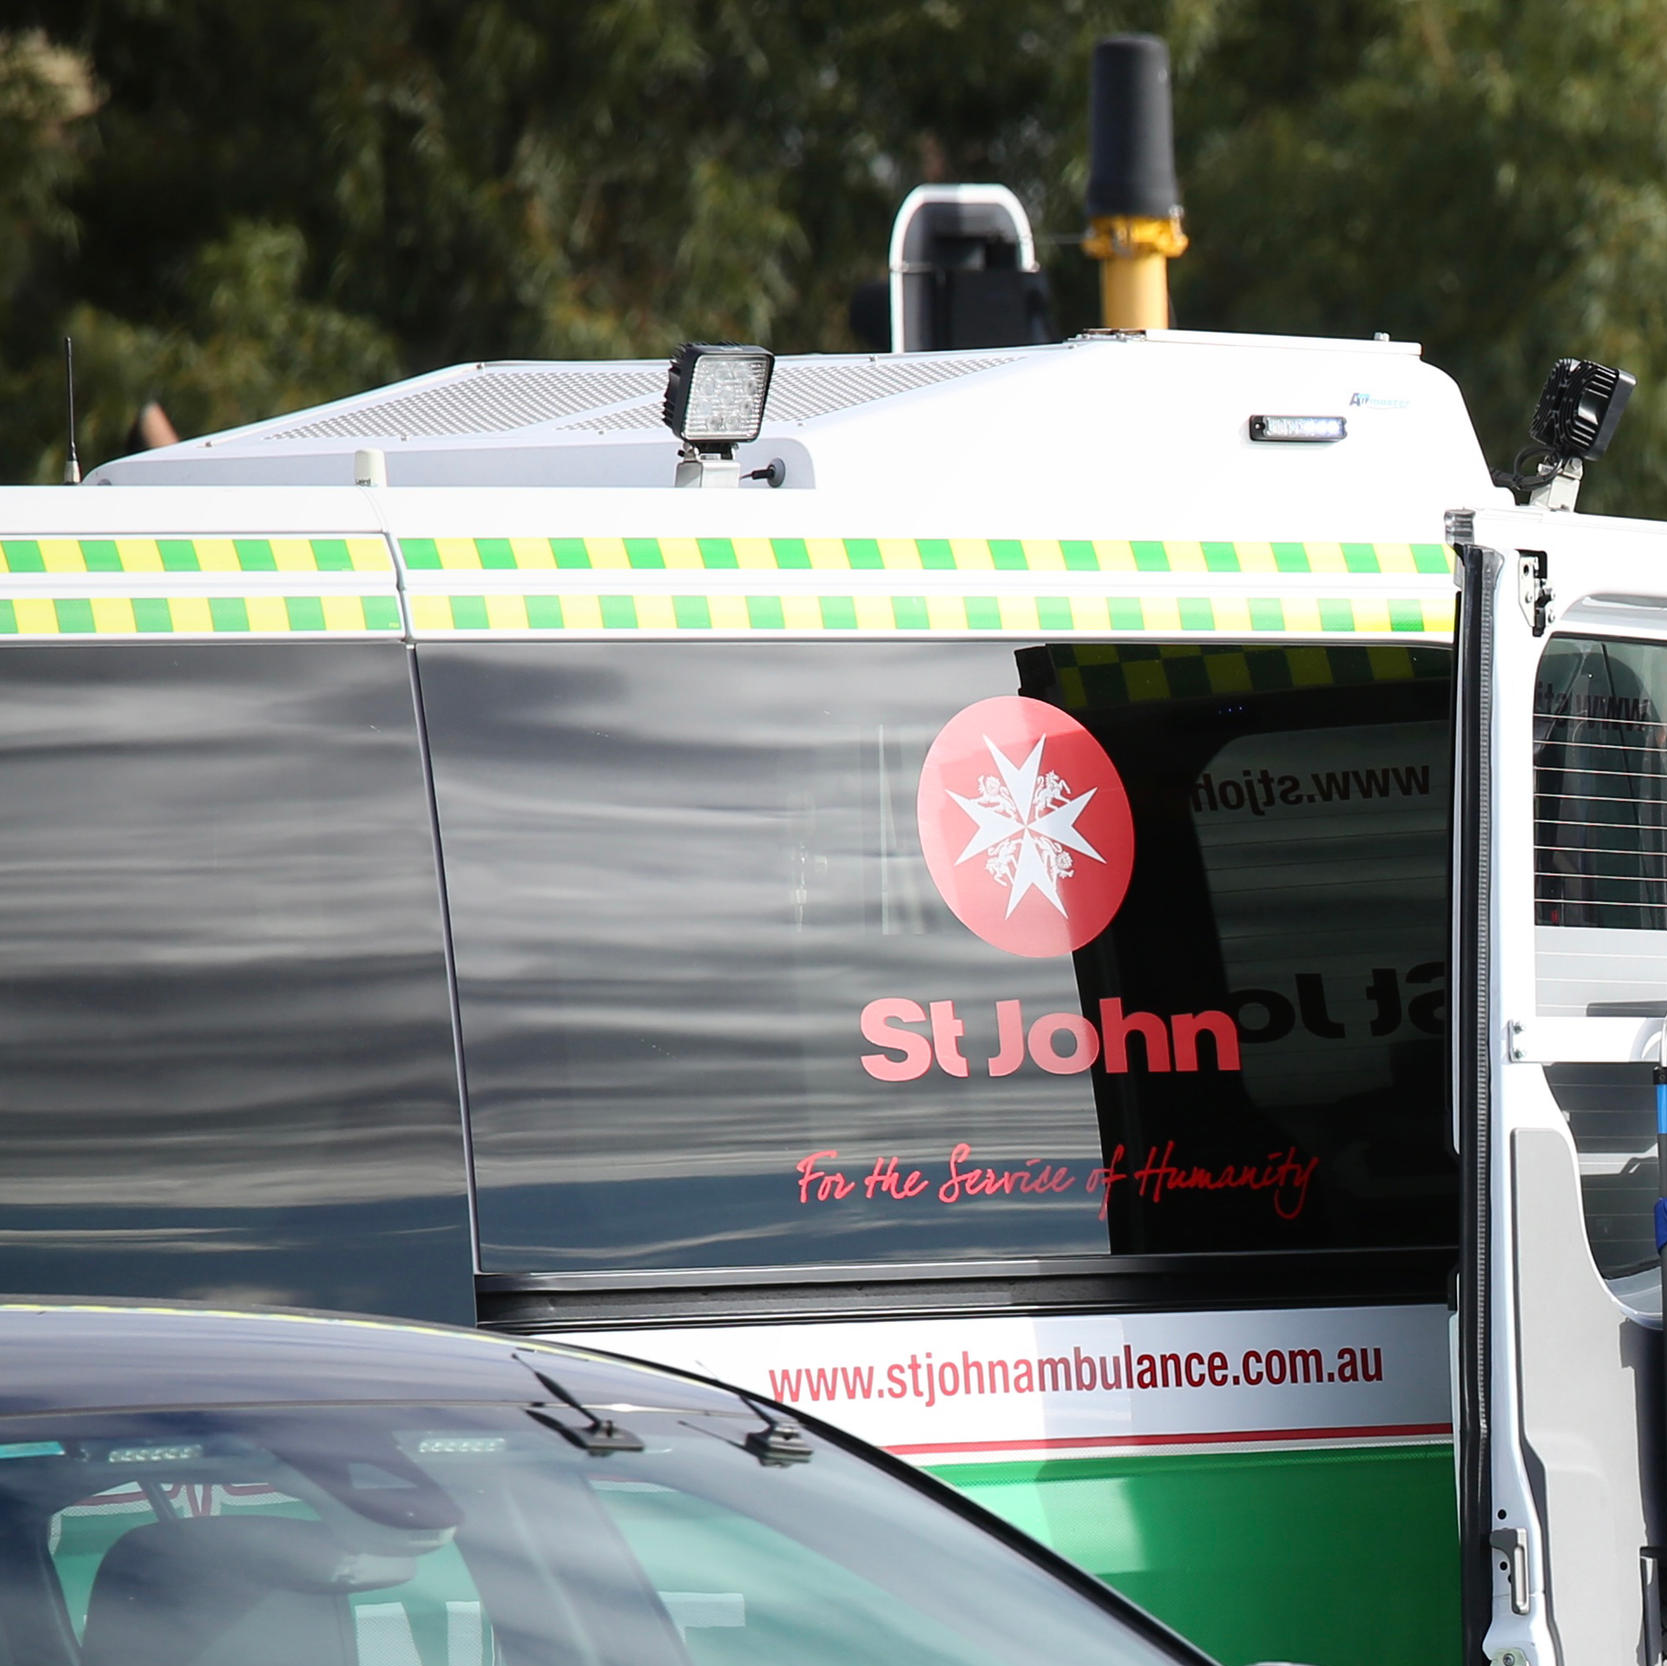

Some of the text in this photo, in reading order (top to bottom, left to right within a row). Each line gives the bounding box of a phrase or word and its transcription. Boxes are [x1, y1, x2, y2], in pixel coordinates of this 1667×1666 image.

[860, 996, 1241, 1082] St John
[796, 1140, 1319, 1220] For the Service of Humanity
[768, 1344, 1385, 1408] www.stjohnambulance.com.au
